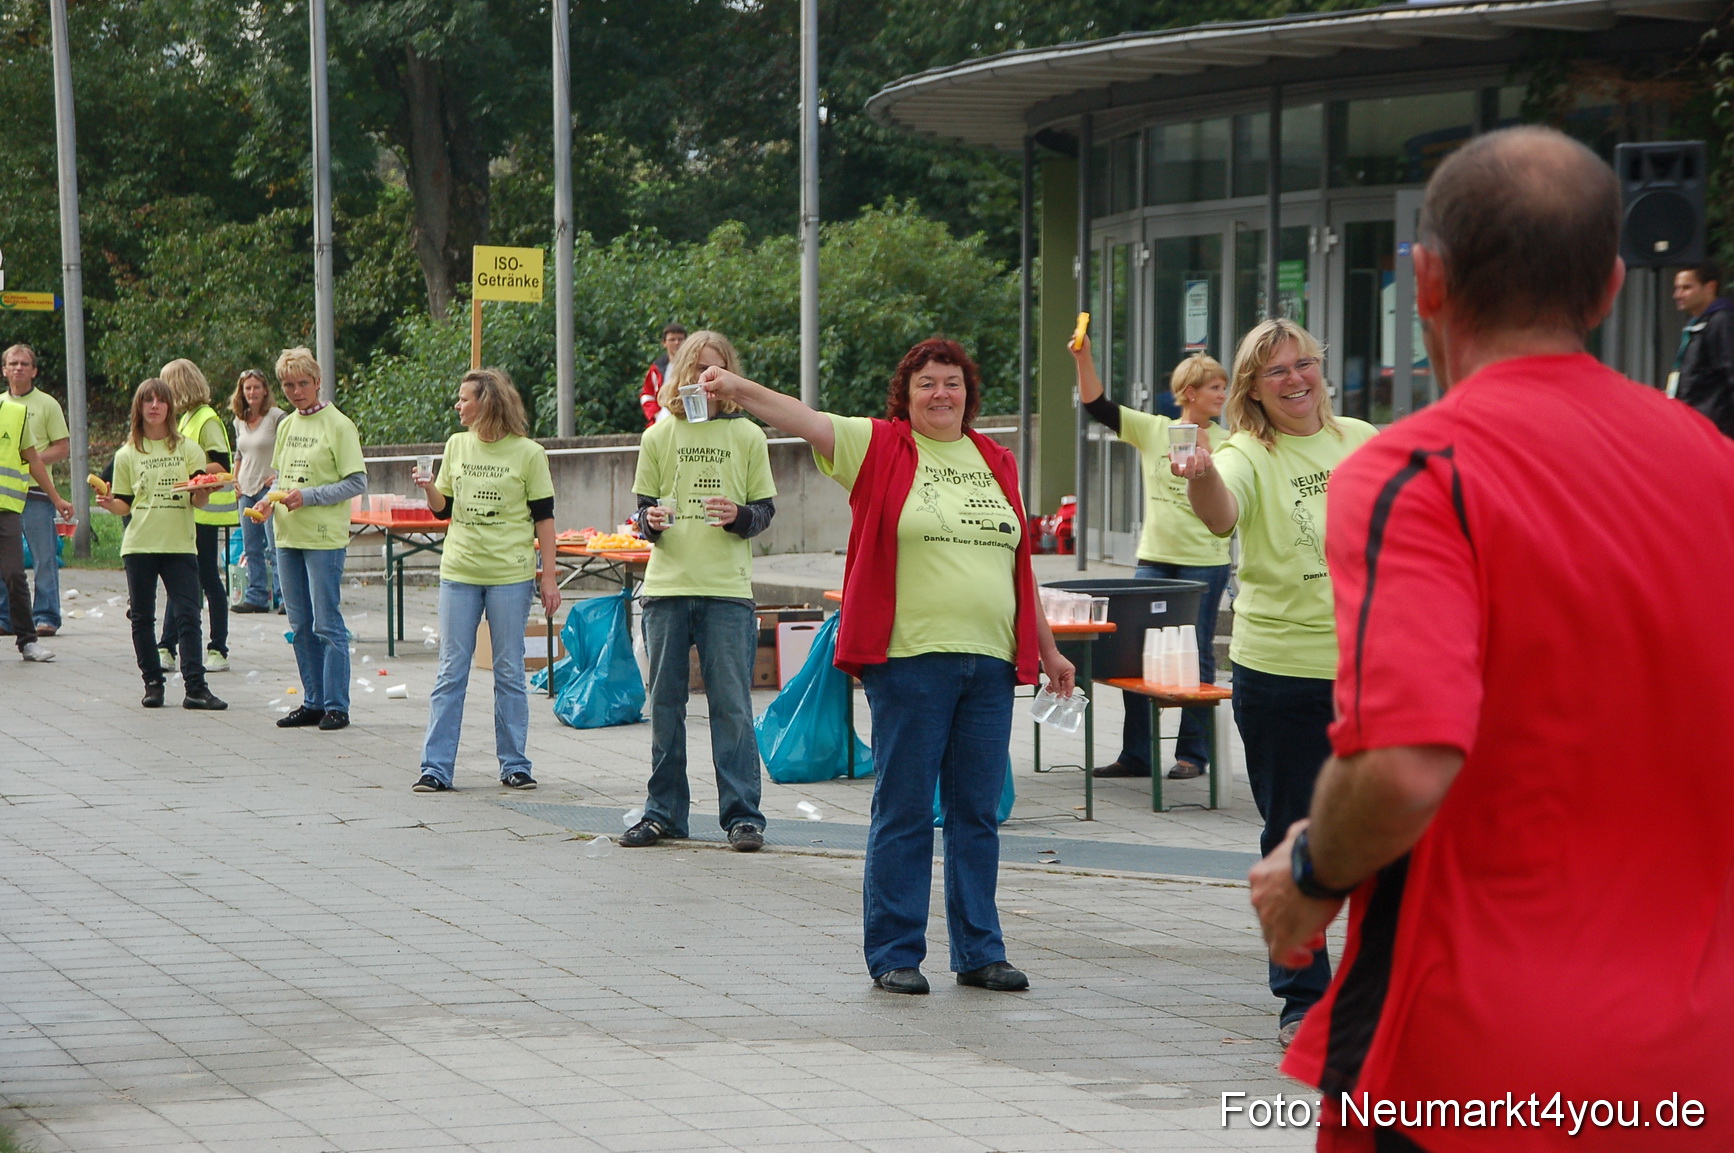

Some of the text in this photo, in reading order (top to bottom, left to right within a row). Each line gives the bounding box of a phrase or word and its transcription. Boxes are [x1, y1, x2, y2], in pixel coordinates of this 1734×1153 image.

[494, 256, 524, 271] ISO-
[477, 272, 540, 288] Getränke
[140, 456, 185, 466] NEUMARKTER
[679, 455, 725, 464] STADTLAUF
[145, 461, 180, 470] STADTLAUF
[461, 463, 510, 473] NEUMARKTER
[463, 470, 504, 478] STADTLAUF
[925, 465, 995, 483] NEUMRKTER
[1290, 469, 1335, 488] NEUMA
[924, 535, 951, 543] Danke
[953, 536, 971, 544] Euer
[1303, 572, 1328, 581] Danke
